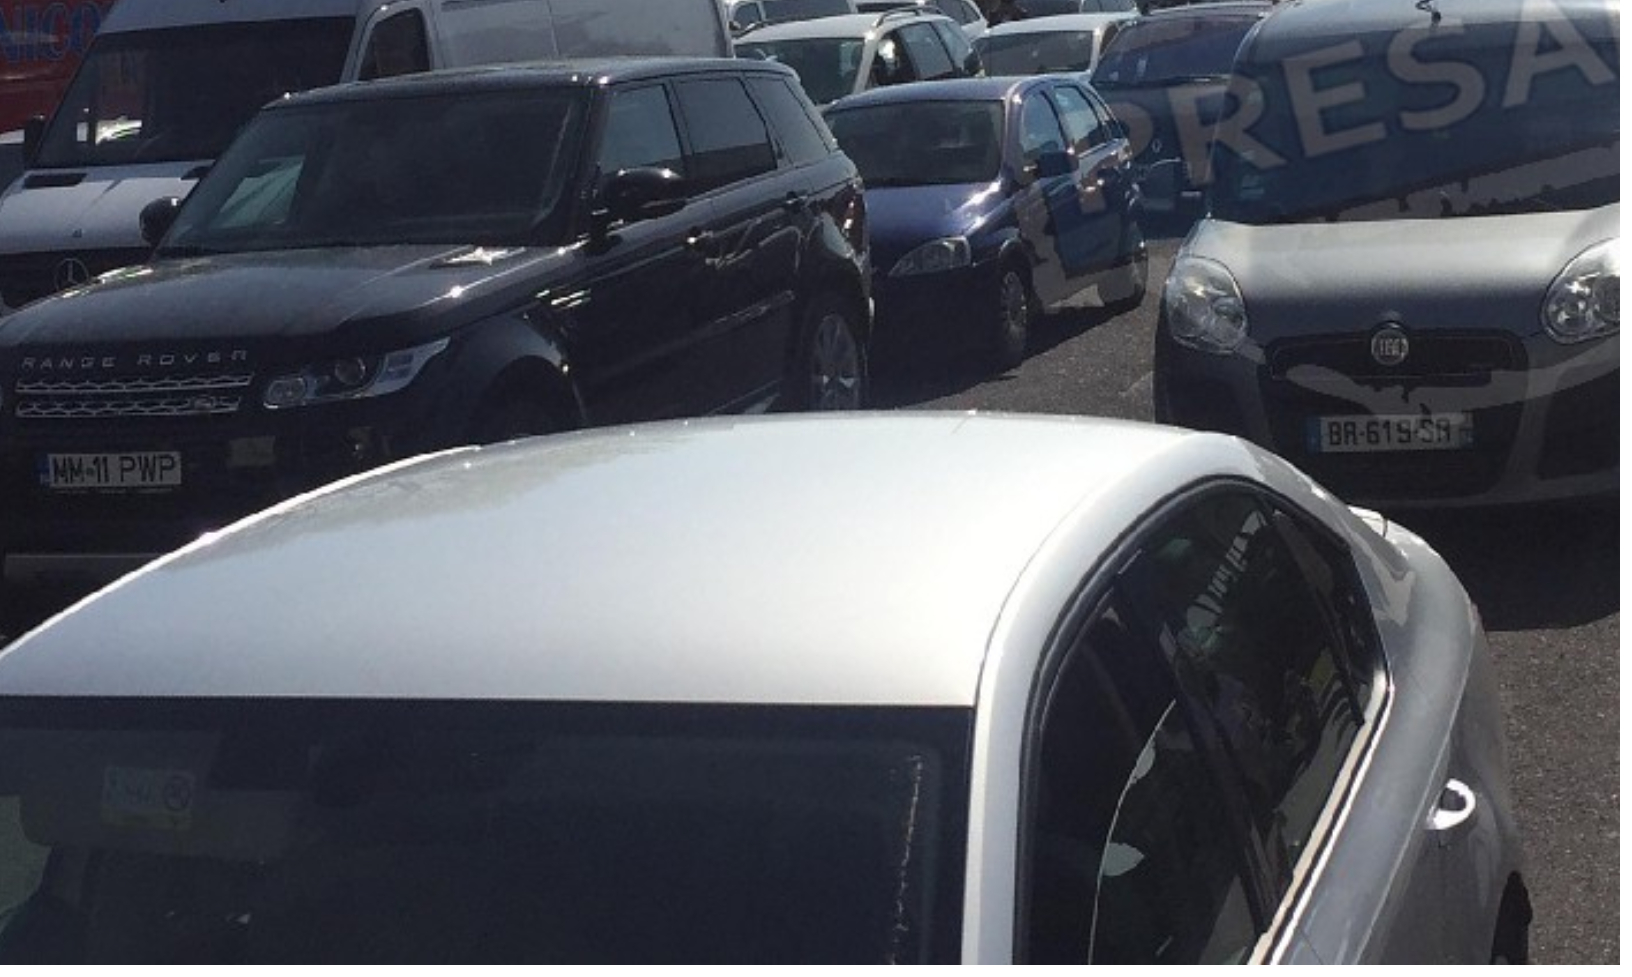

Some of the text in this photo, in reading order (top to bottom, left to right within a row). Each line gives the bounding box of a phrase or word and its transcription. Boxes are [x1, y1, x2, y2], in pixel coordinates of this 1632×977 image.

[22, 348, 250, 370] RANGE ROVER
[53, 454, 176, 484] MM-11 PWP
